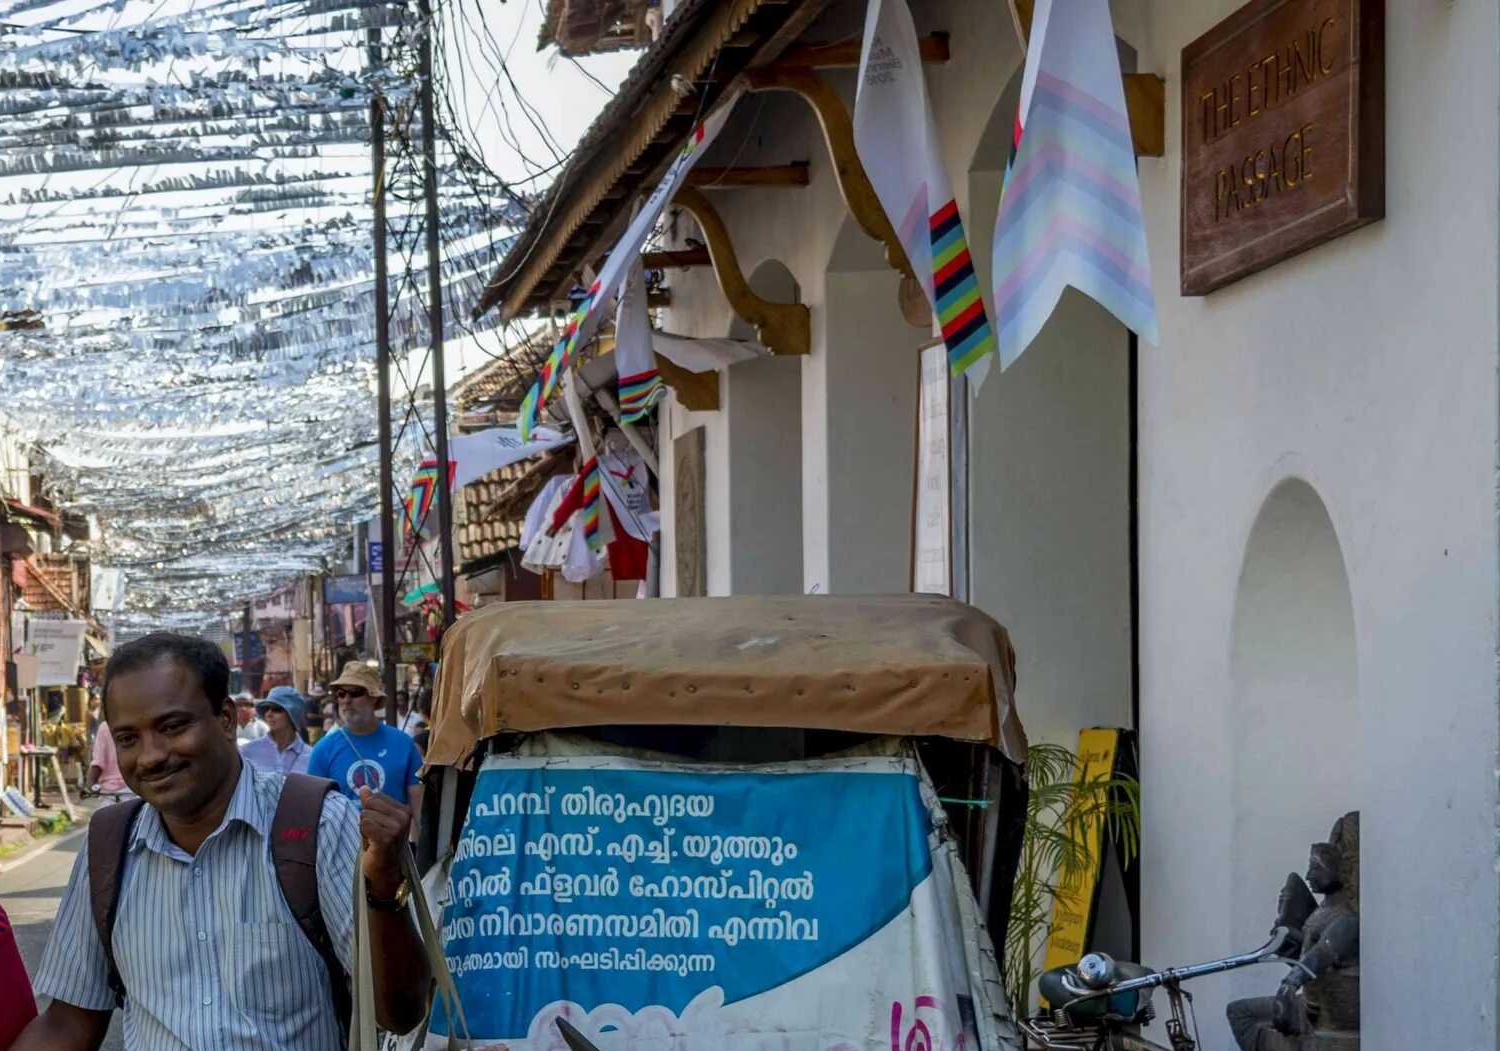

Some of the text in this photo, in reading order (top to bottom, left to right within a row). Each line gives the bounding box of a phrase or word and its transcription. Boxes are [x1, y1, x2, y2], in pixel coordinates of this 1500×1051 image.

[1200, 17, 1337, 144] THE ETHNIC
[1215, 122, 1313, 222] PASSAGE
[708, 910, 819, 946] എന്നിവ
